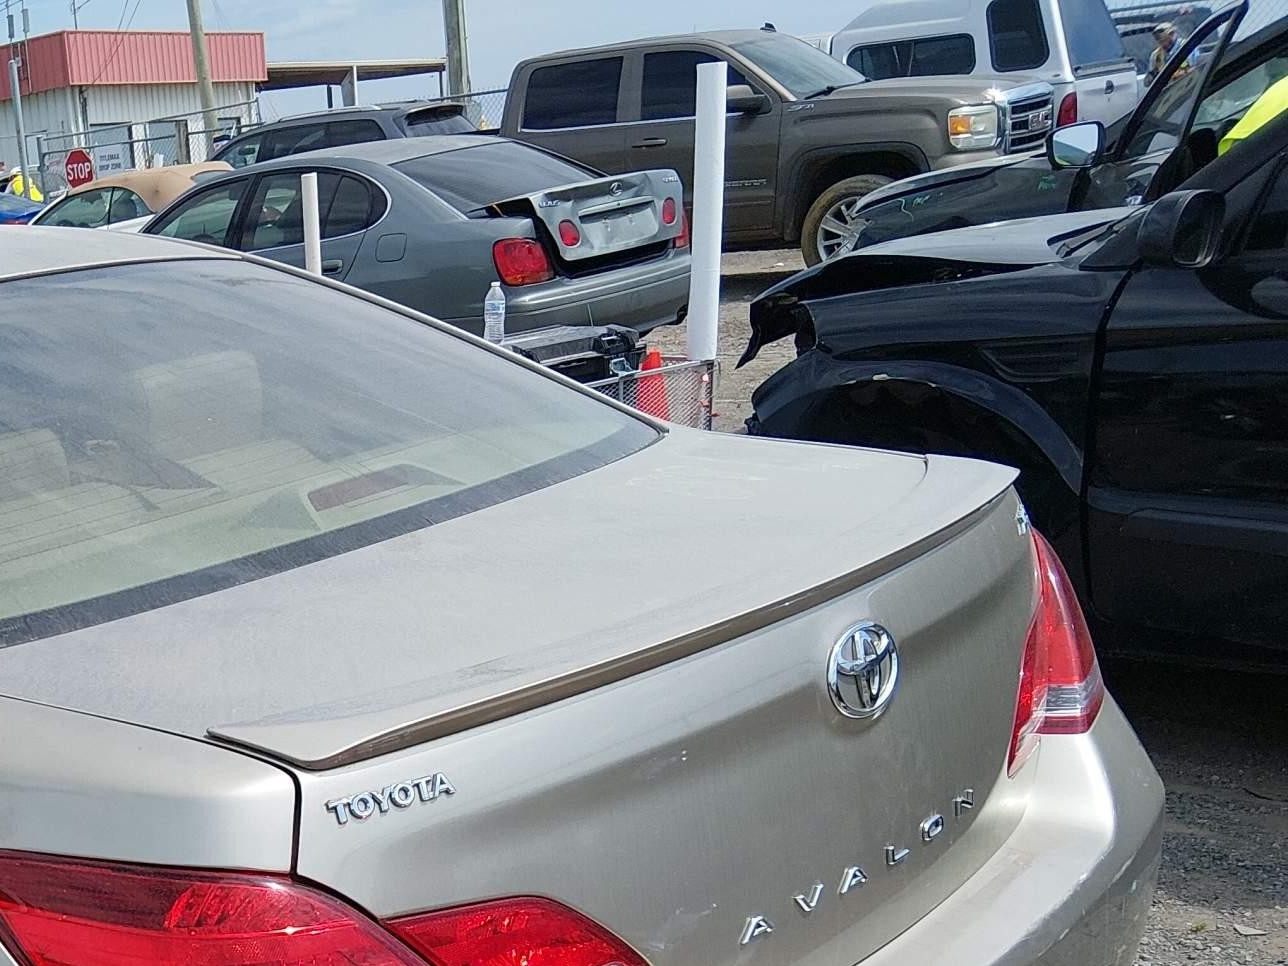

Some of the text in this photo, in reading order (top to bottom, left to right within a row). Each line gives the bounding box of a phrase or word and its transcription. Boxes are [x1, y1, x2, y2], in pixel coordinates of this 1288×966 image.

[67, 162, 91, 180] STOP
[324, 771, 456, 825] TOYOTA
[739, 788, 975, 945] AVALON
